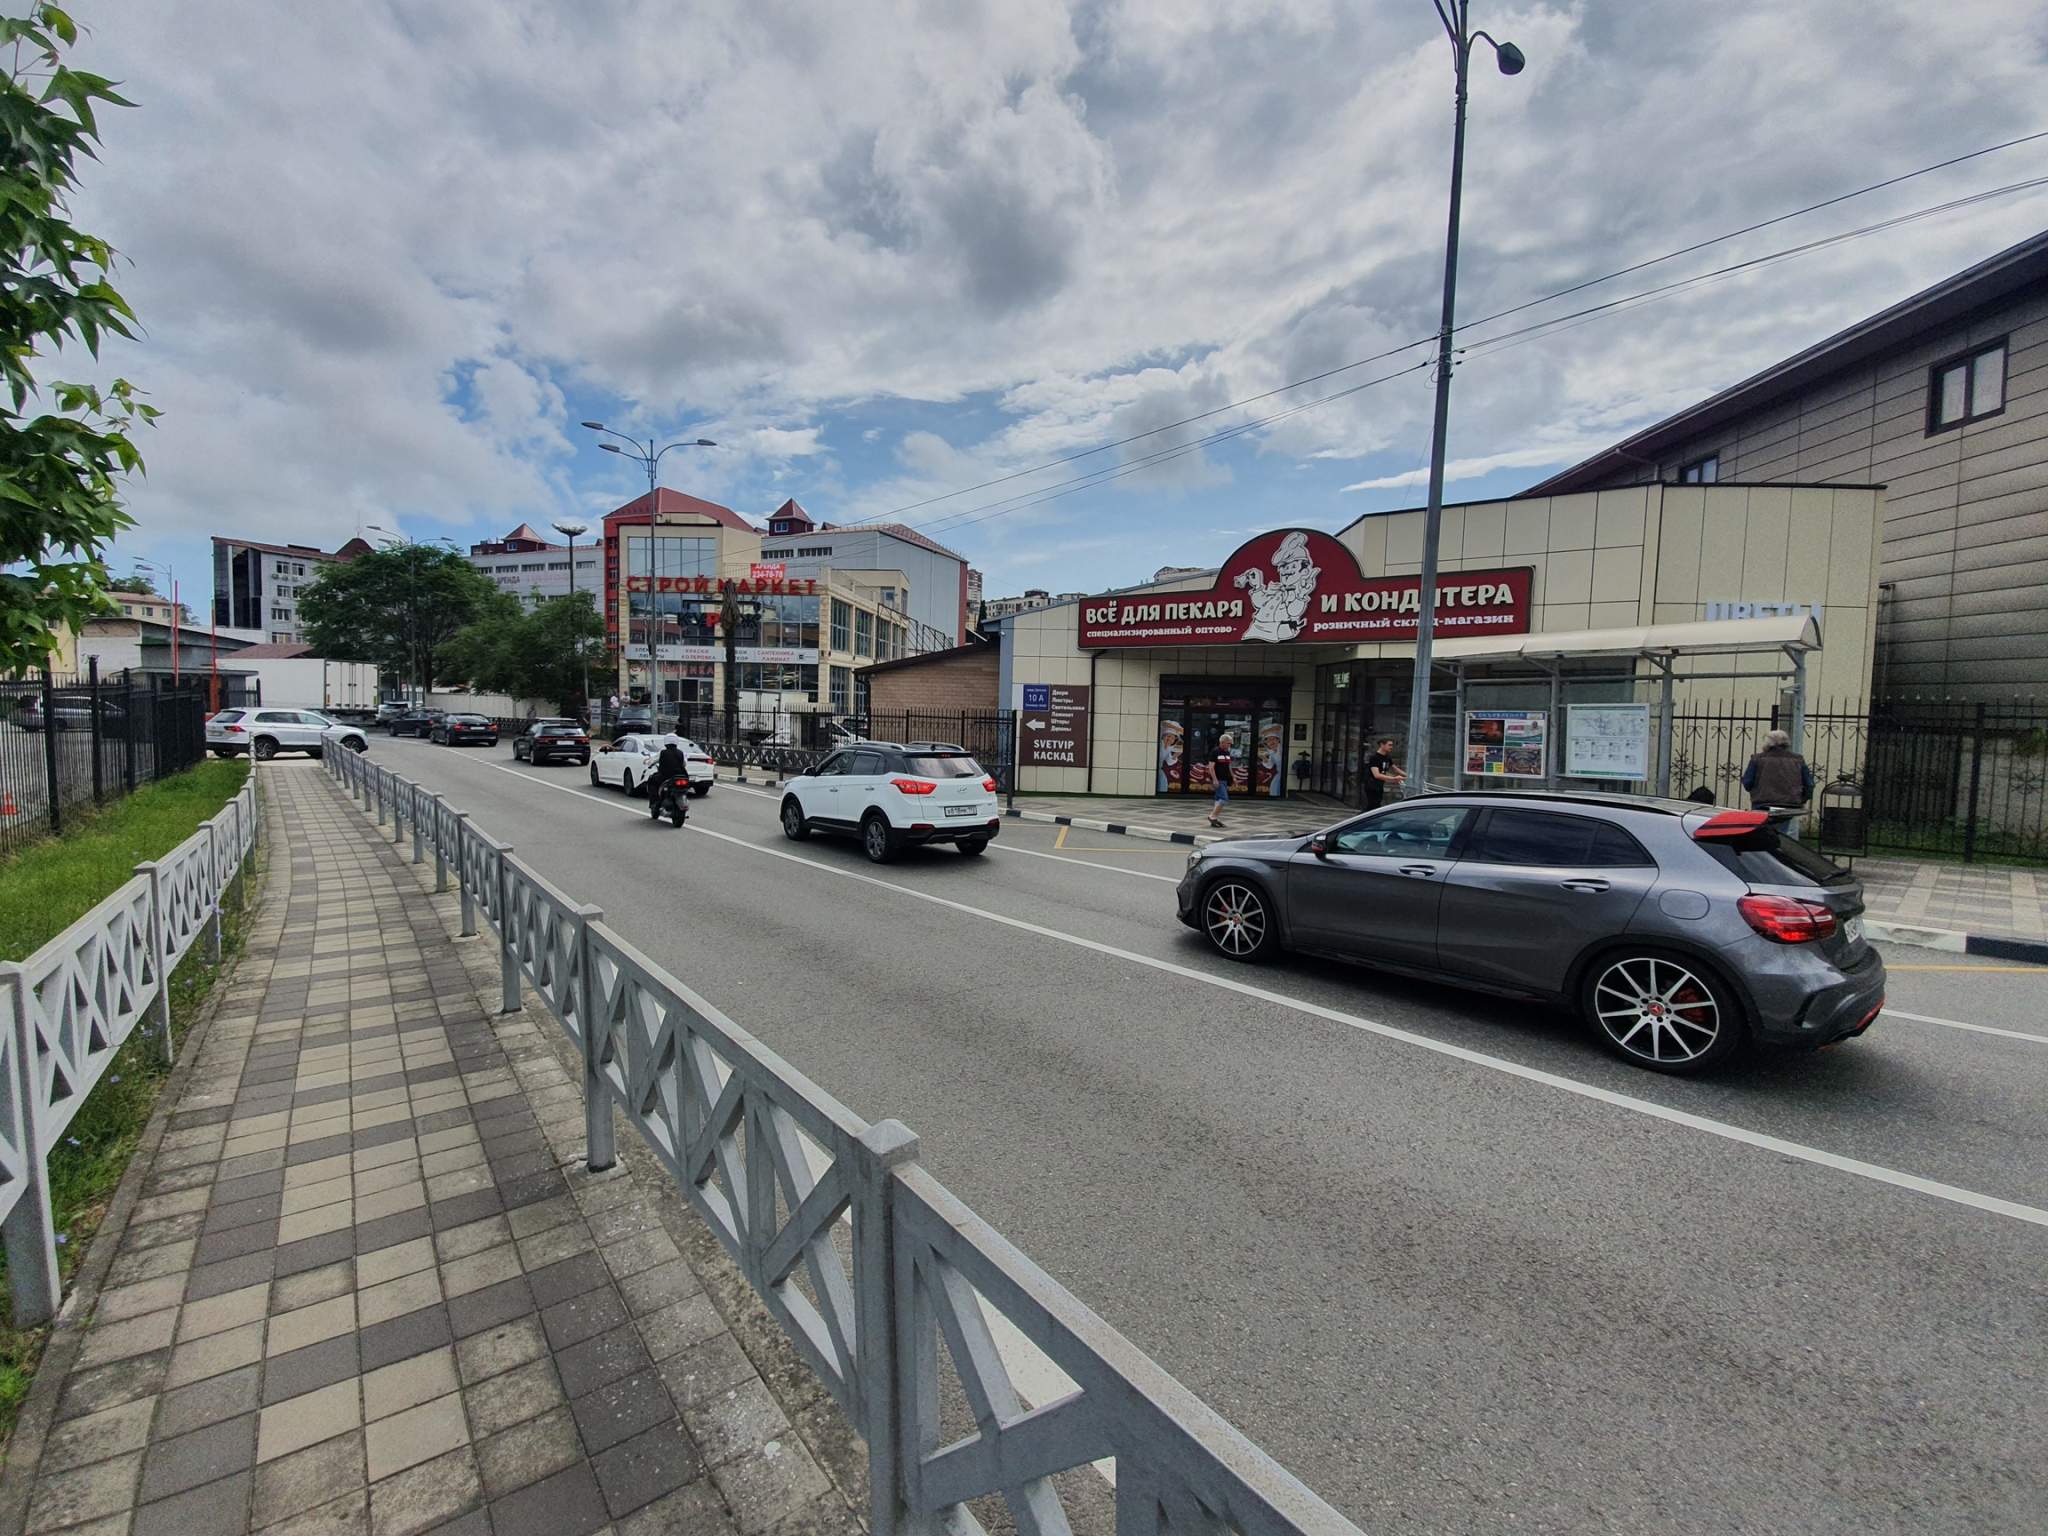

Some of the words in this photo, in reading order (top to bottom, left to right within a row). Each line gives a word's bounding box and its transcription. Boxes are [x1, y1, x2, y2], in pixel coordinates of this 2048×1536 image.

[627, 574, 709, 593] СТРОЙ
[1086, 600, 1118, 624] ВСЁ
[1121, 604, 1161, 626] ДЛЯ
[1165, 599, 1243, 620] ПЕКАРЯ
[1320, 594, 1338, 613] И
[677, 612, 762, 627] КУРЖ
[1086, 626, 1193, 638] специализированный
[1195, 626, 1237, 635] оптово-
[1313, 617, 1391, 633] розничный
[1393, 614, 1514, 628] склд-магазин
[630, 663, 715, 674] САТЕХНИКА
[1029, 694, 1038, 702] 10
[1033, 739, 1075, 749] SVETVIP
[1033, 751, 1074, 762] КАСКАД
